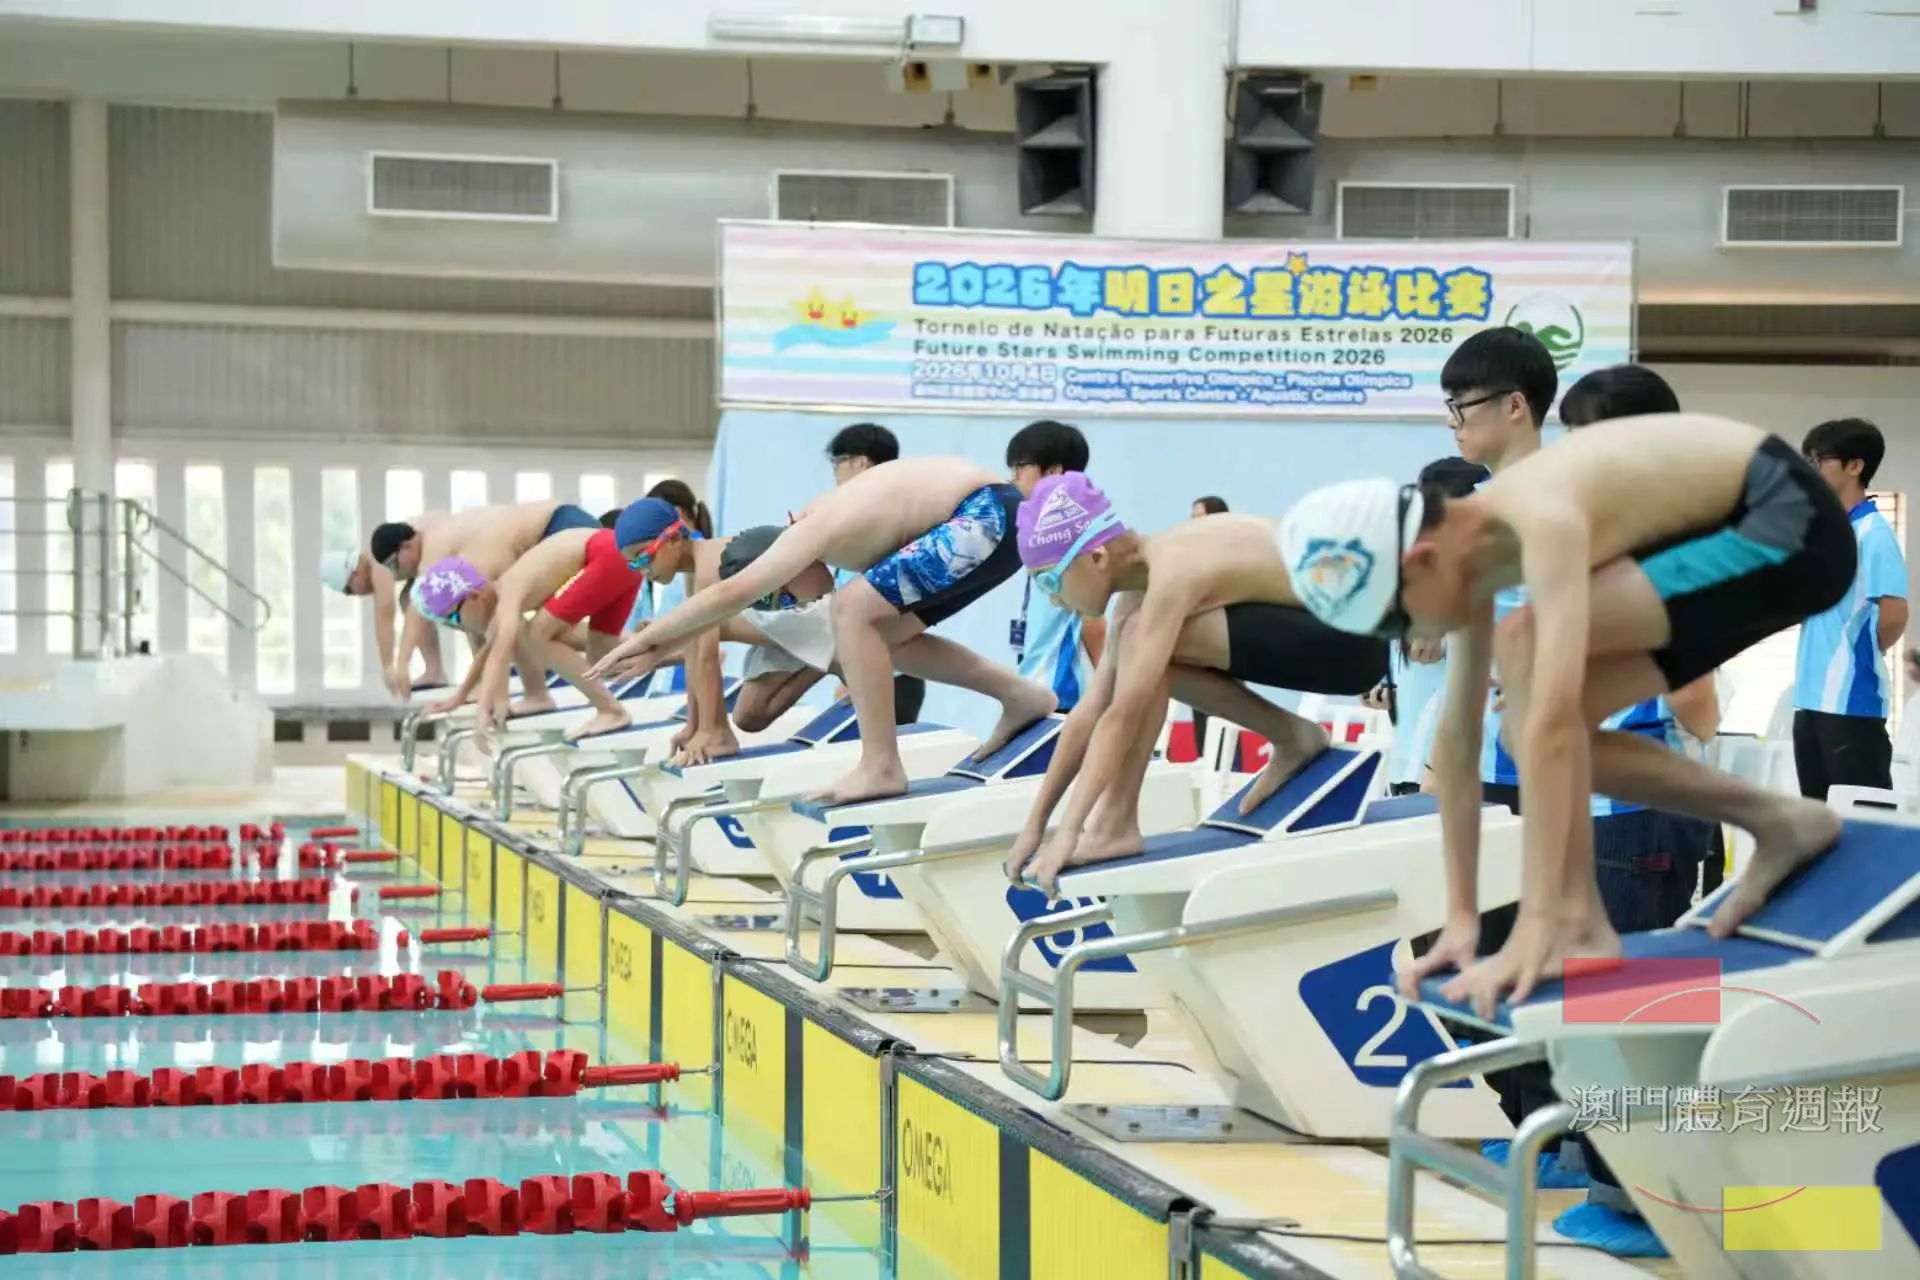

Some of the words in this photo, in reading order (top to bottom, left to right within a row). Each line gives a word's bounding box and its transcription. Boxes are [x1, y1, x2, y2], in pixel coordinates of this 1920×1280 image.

[914, 317, 999, 335] Torneio
[1008, 321, 1034, 336] de
[1044, 321, 1135, 342] Natação
[1145, 326, 1195, 342] para
[1205, 325, 1290, 342] Futuras
[1301, 326, 1393, 343] Estrelas
[1401, 327, 1453, 343] 2026
[914, 339, 988, 356] Future
[1000, 341, 1057, 358] Stars
[1067, 344, 1180, 363] Swimming
[1189, 346, 1326, 365] Competition
[1333, 350, 1386, 365] 2026
[1354, 985, 1408, 1067] 2
[902, 1117, 954, 1205] OMEGA
